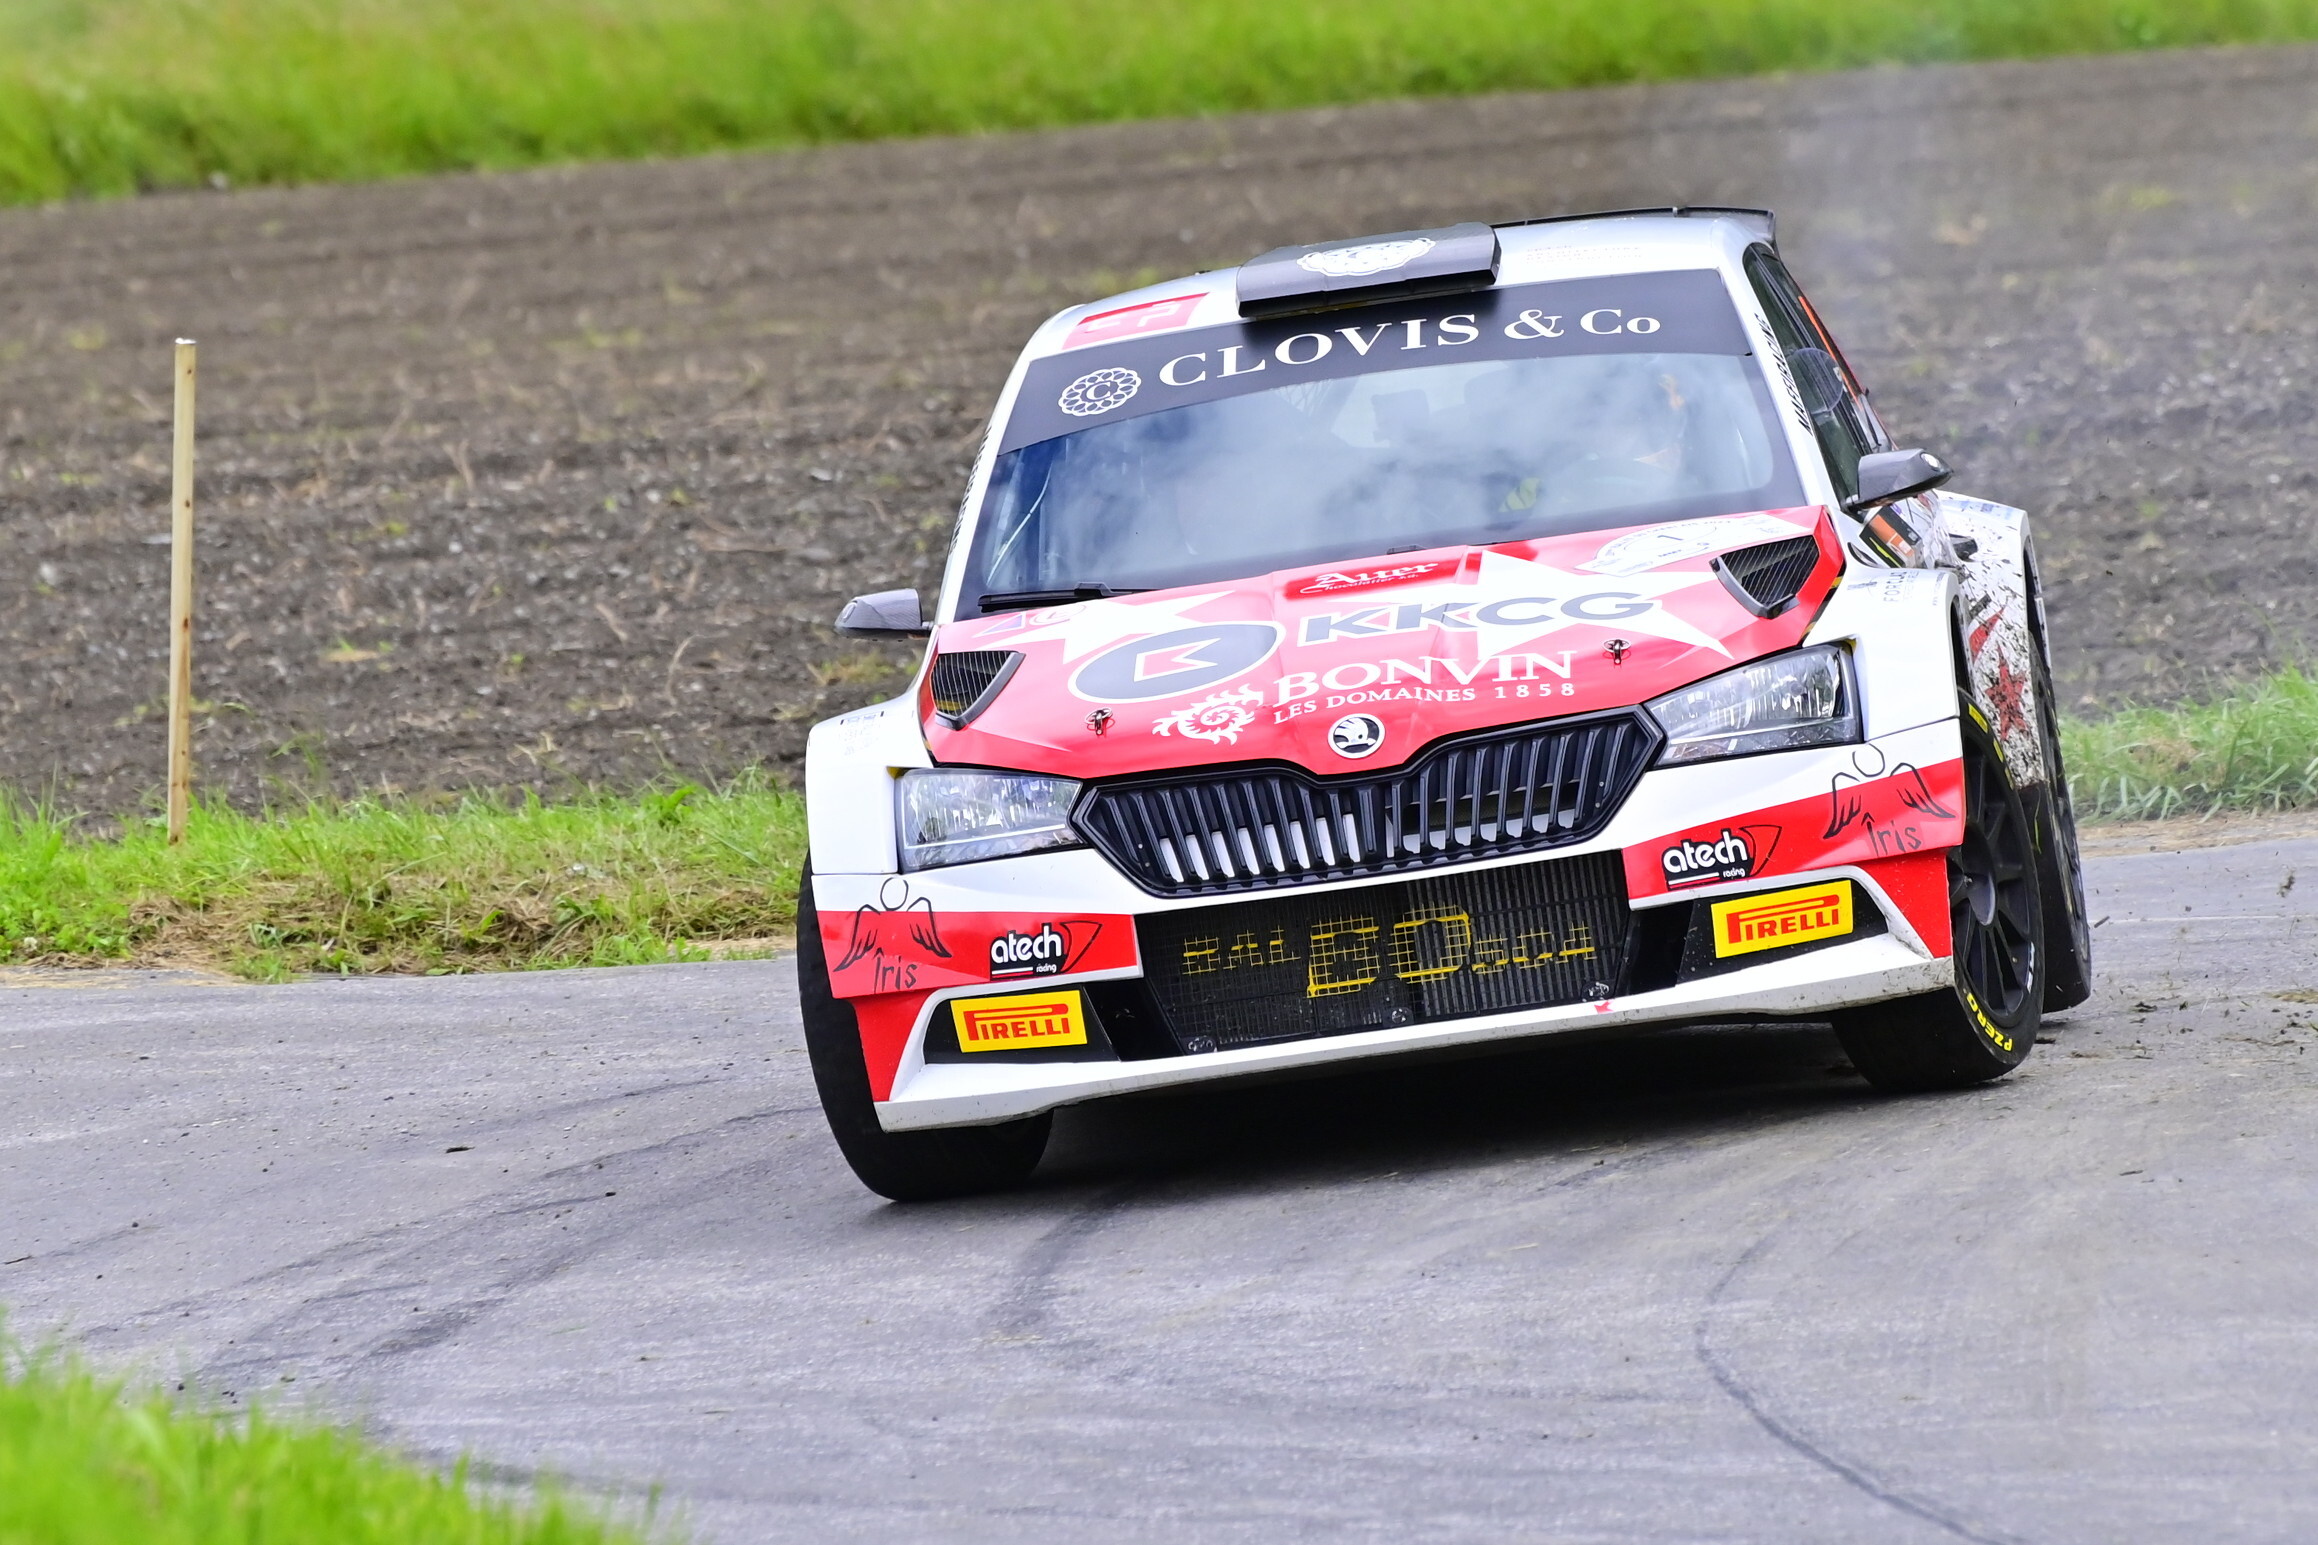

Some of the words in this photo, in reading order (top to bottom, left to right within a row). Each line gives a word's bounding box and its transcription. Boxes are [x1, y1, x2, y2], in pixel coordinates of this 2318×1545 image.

[1159, 313, 1479, 386] CLOVIS
[1503, 309, 1564, 340] &
[1580, 308, 1661, 334] Co
[1301, 591, 1654, 645] KKCG
[1272, 650, 1578, 707] BONVIN
[1273, 699, 1317, 725] LES
[1326, 685, 1476, 709] DOMAINES
[1663, 831, 1747, 873] atech
[1723, 867, 1746, 878] racing
[1727, 894, 1840, 944] PIRELLI
[991, 925, 1062, 964] atech
[963, 1003, 1070, 1041] PIRELLI
